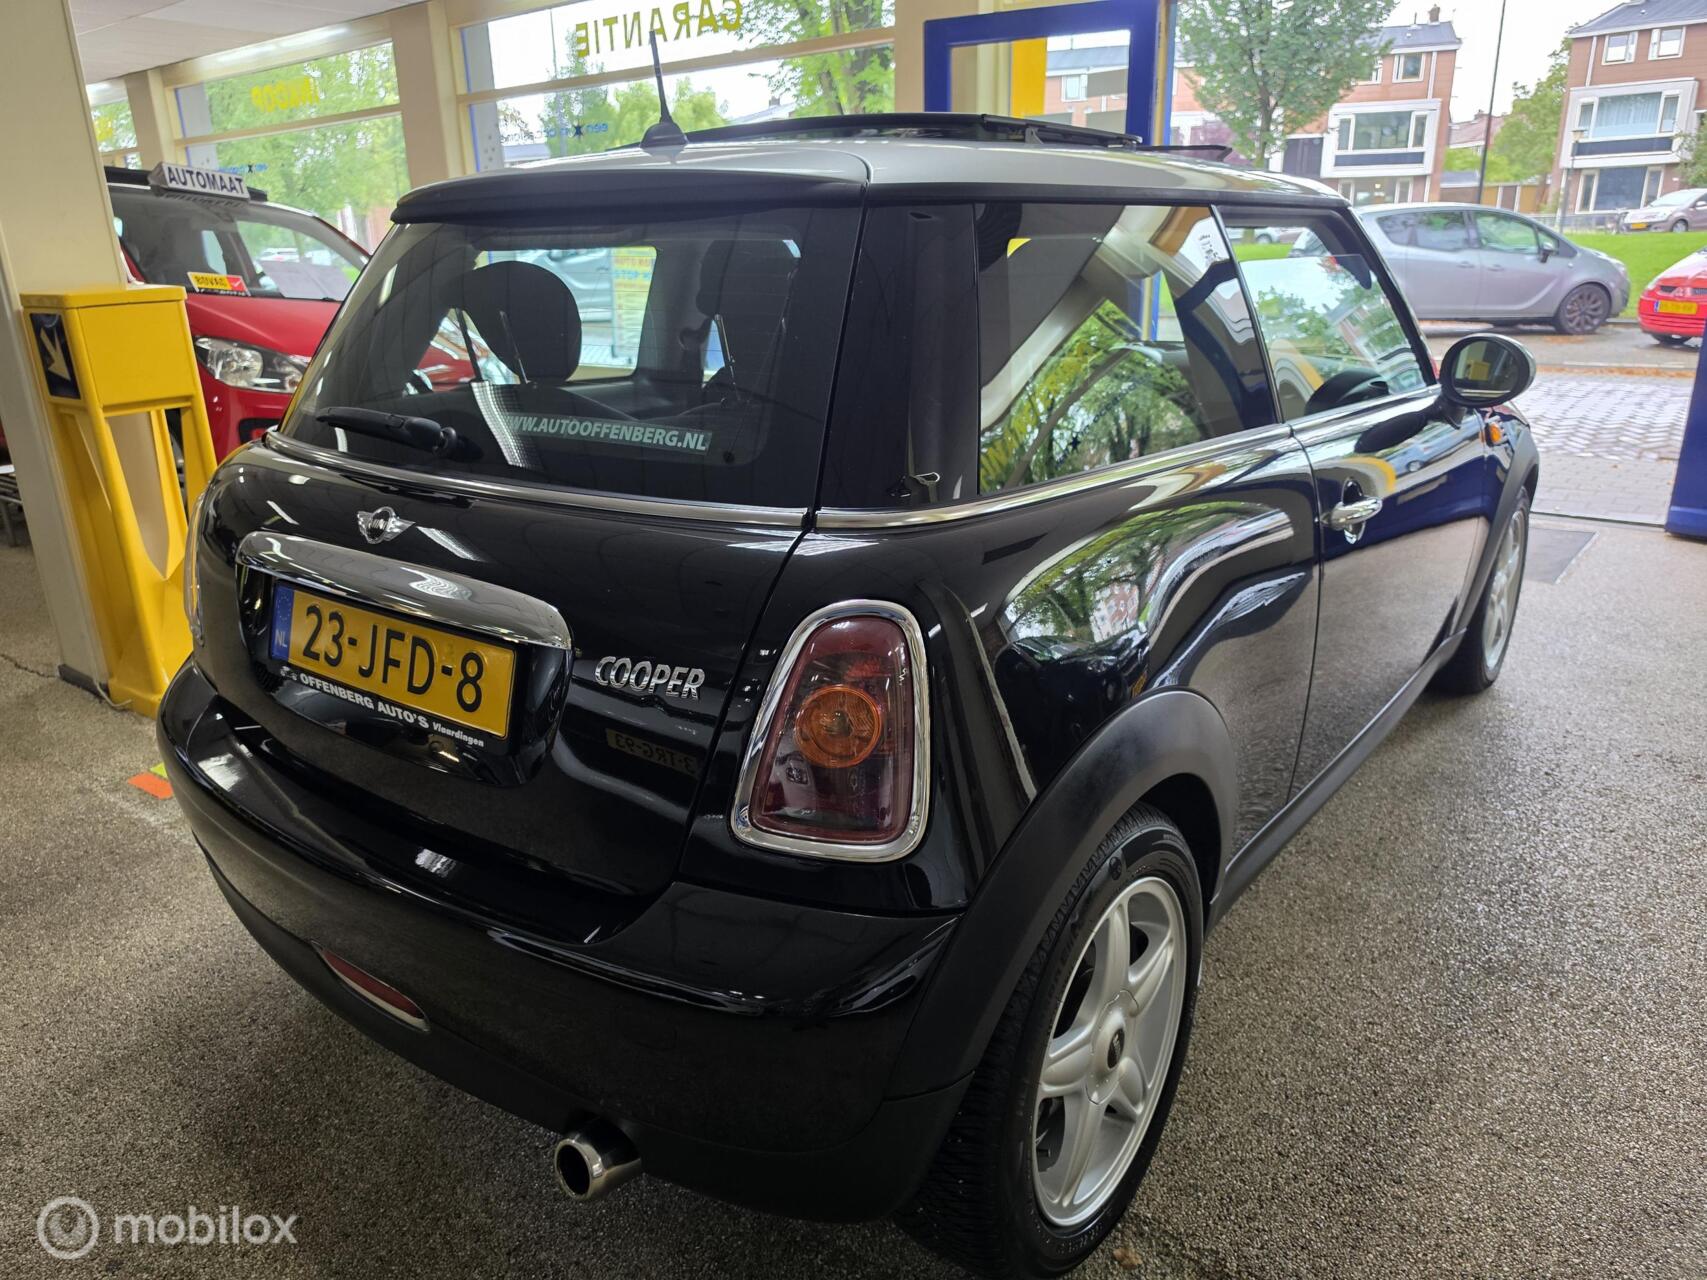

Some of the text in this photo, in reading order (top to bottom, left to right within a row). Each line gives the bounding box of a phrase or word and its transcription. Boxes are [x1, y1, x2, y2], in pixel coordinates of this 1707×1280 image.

[167, 167, 245, 194] AUTOMAAT
[503, 414, 707, 451] WW.AUTOOFFENBERG.NL
[275, 630, 288, 648] NL
[303, 605, 484, 713] 23-JFD-8
[594, 656, 706, 700] COOPER
[299, 674, 484, 748] OFFENBERG AUTO'S Vlaardingen
